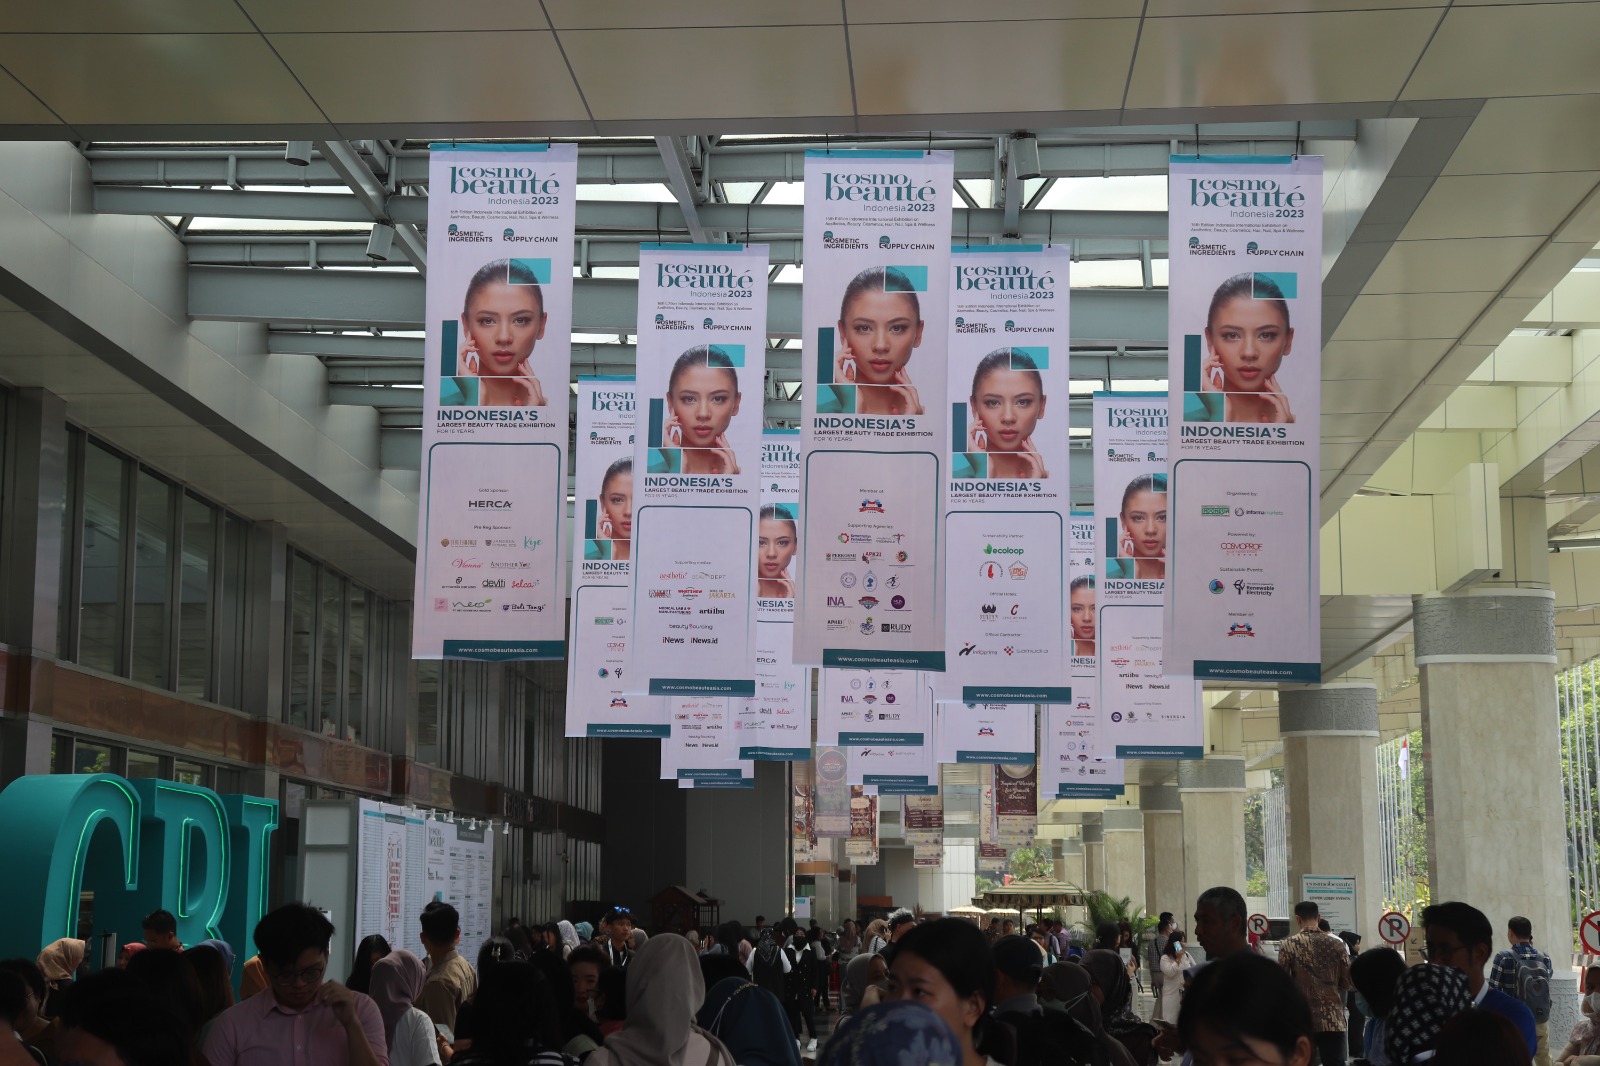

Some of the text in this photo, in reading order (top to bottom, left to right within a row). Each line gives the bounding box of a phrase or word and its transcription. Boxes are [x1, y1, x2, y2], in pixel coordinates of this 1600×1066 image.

[459, 167, 532, 178] cosmo
[450, 166, 560, 194] beauté
[834, 174, 908, 184] cosmo
[1199, 179, 1276, 190] cosmo
[823, 173, 936, 201] beauté
[1187, 179, 1305, 207] beauté
[1276, 210, 1304, 218] 2023
[665, 264, 729, 273] cosmo
[964, 266, 1029, 275] cosmo
[655, 263, 753, 288] beauté
[955, 266, 1054, 290] beauté
[590, 391, 635, 411] bea
[437, 410, 538, 420] INDONESIA'S
[1114, 408, 1167, 416] cosmo
[814, 418, 915, 429] INDONESIA'S
[1106, 408, 1168, 428] beau
[1181, 426, 1286, 438] INDONESIA'S
[761, 448, 800, 462] aut
[645, 478, 733, 487] INDONESIA'S
[951, 483, 1041, 491] INDONESIA'S
[993, 547, 1024, 555] ecoloop
[827, 597, 845, 605] INA
